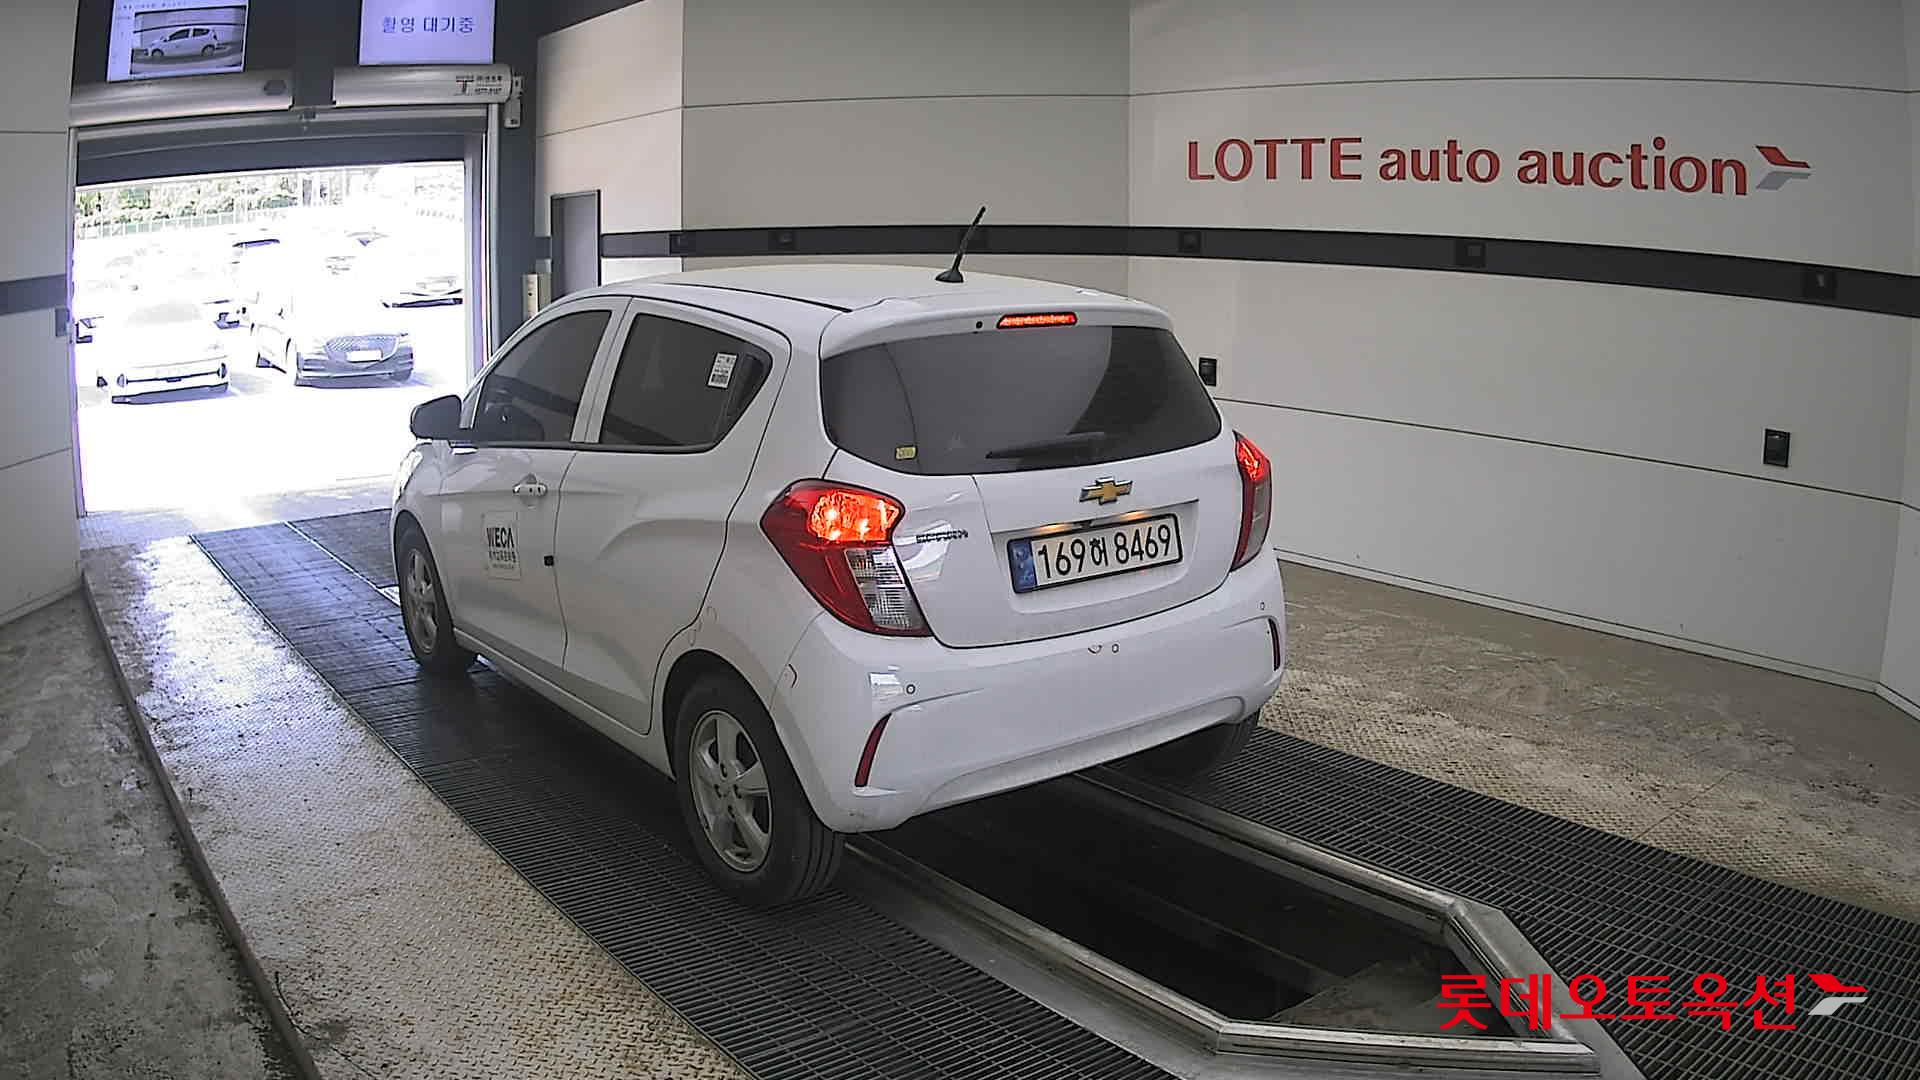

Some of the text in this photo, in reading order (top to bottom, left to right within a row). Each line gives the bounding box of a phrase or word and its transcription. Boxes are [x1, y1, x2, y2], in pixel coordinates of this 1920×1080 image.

[424, 15, 474, 33] 대기중
[1188, 136, 1748, 195] LOTTE auto auction
